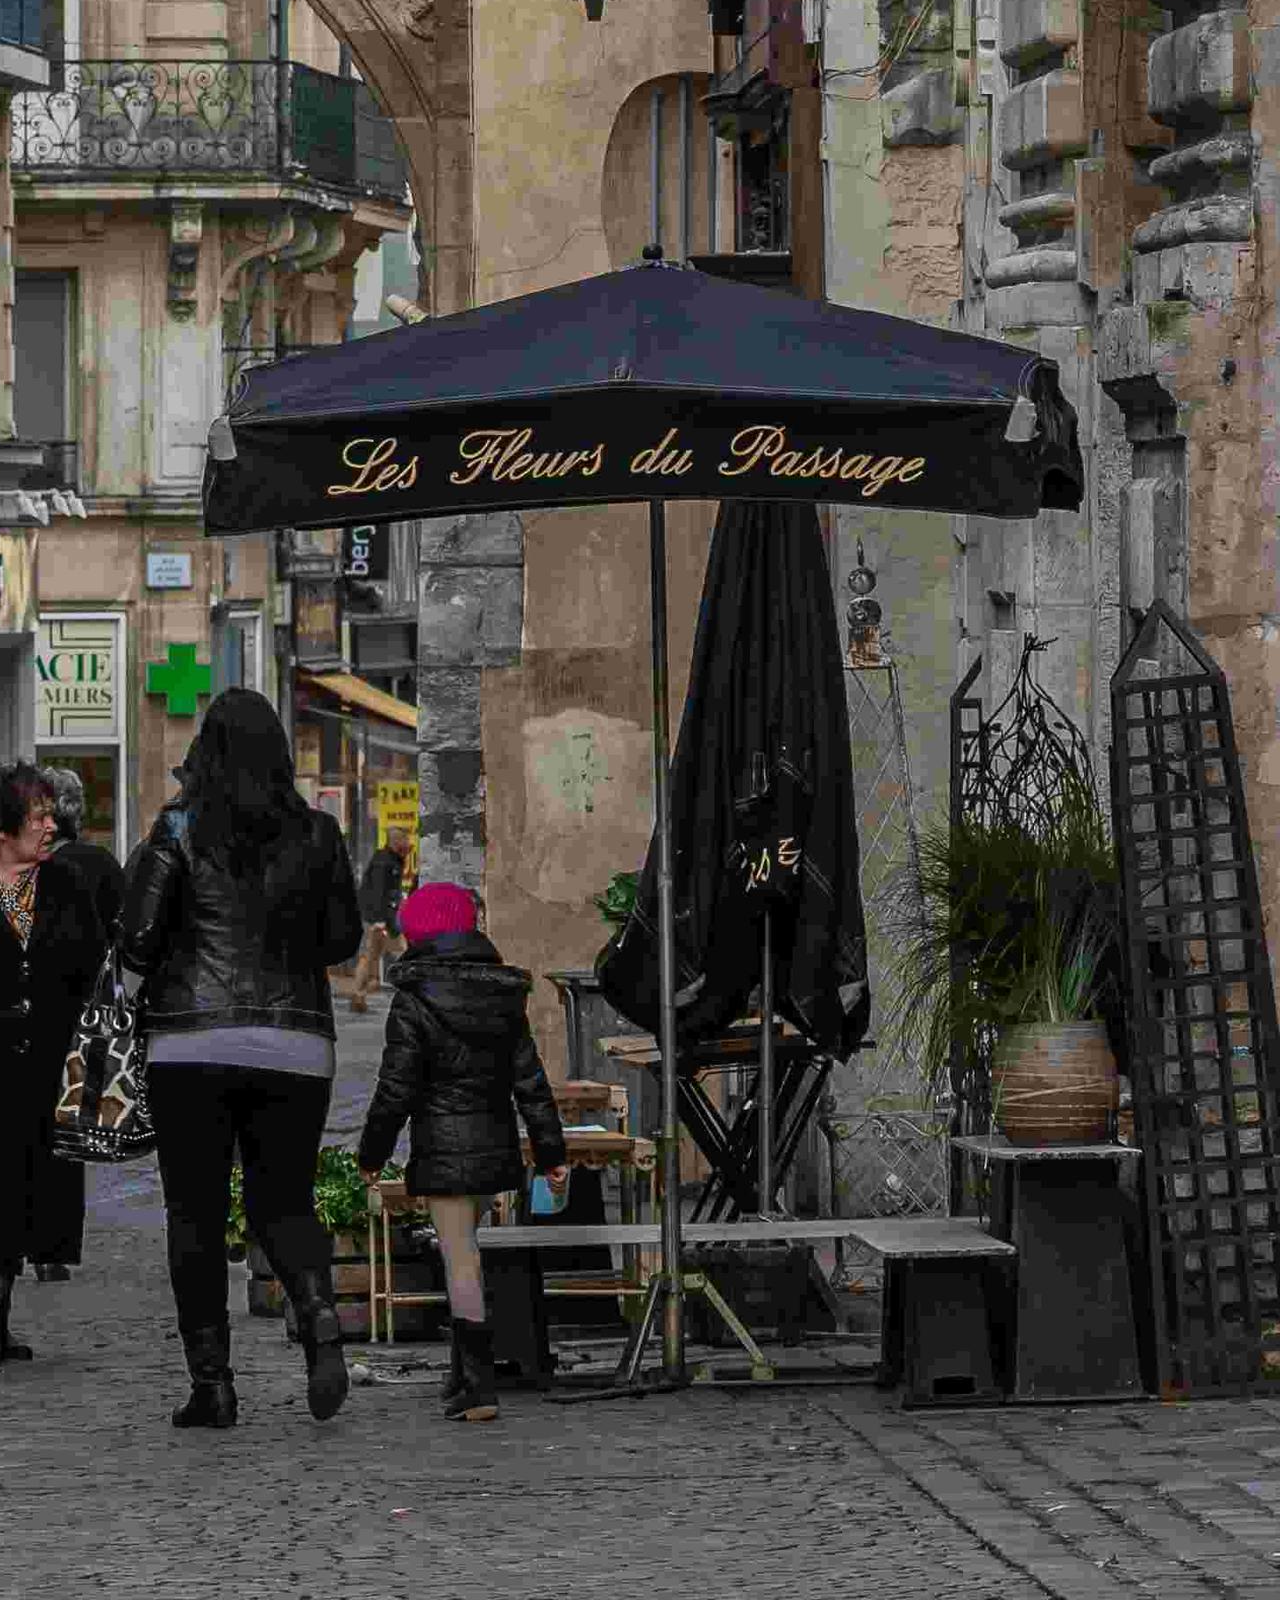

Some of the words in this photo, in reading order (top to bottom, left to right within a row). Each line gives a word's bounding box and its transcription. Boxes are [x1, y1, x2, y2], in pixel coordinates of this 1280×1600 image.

[327, 437, 420, 495] Les
[450, 427, 605, 484] Fleurs
[630, 428, 693, 475] du
[718, 425, 925, 497] Passage
